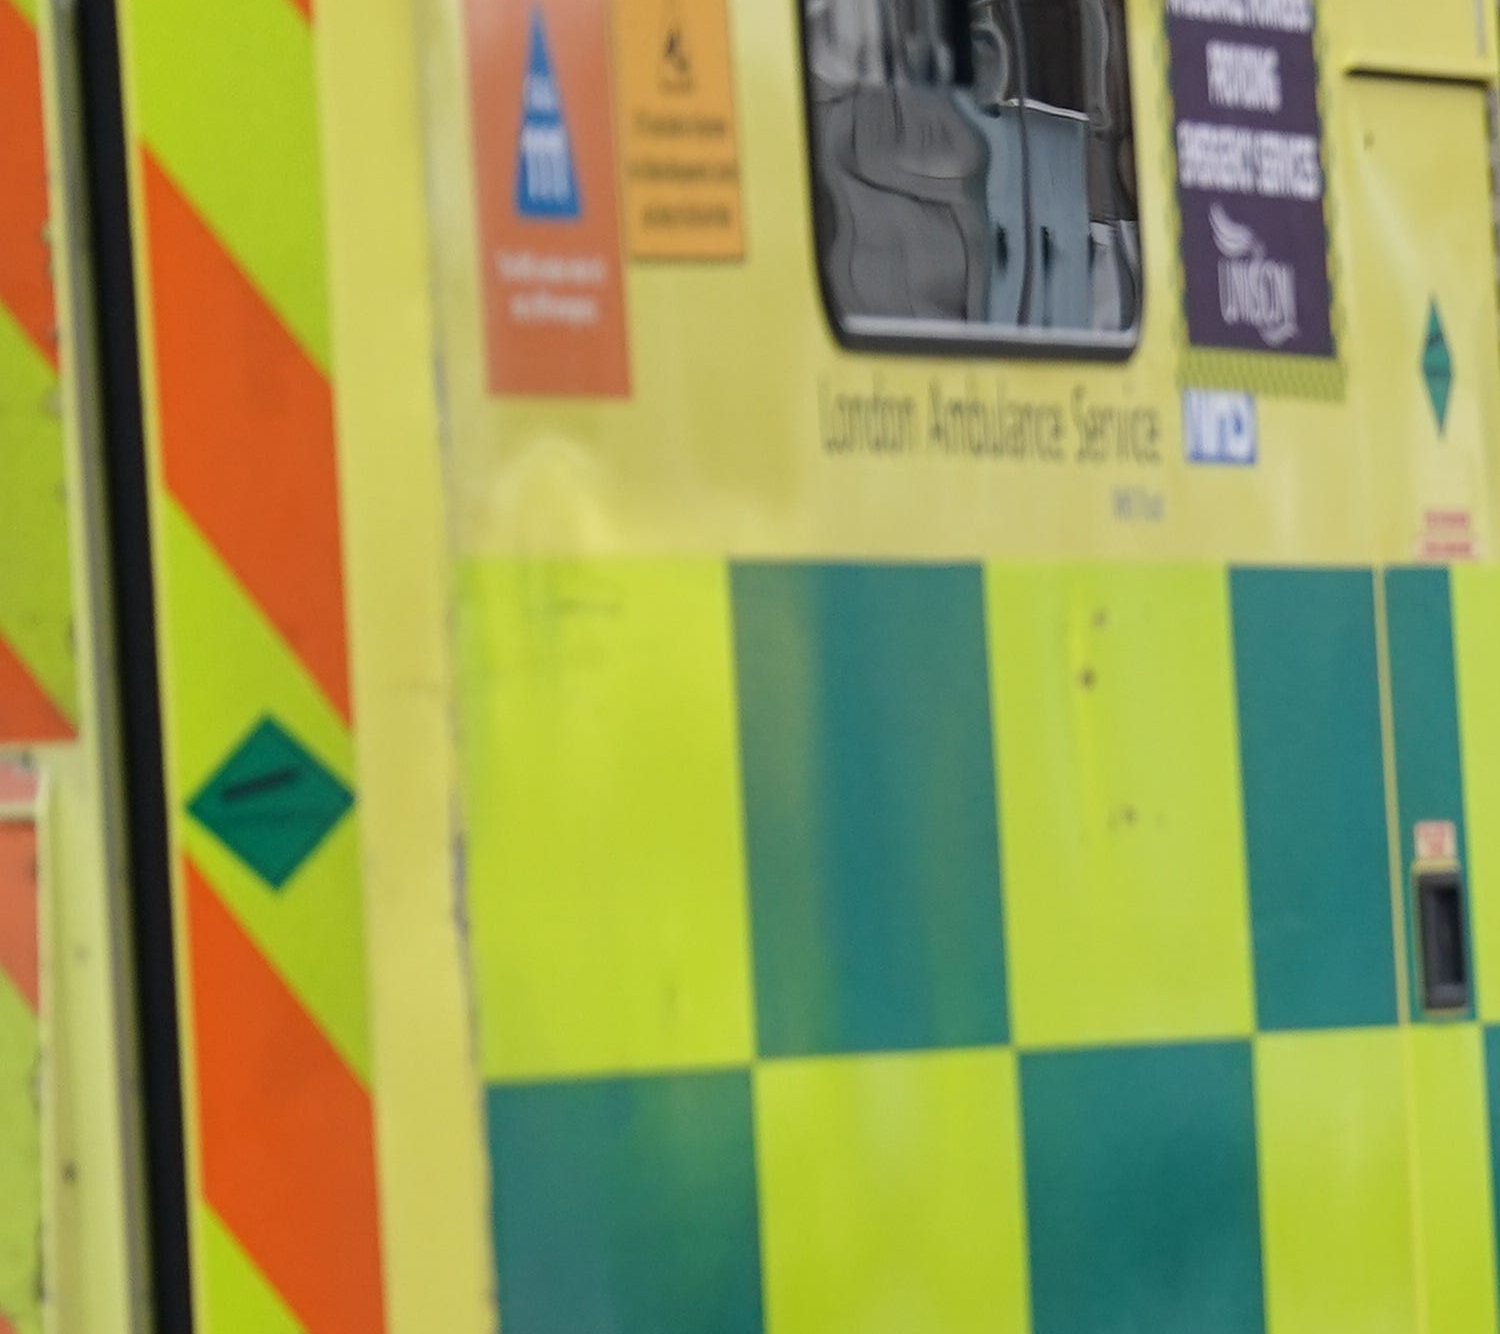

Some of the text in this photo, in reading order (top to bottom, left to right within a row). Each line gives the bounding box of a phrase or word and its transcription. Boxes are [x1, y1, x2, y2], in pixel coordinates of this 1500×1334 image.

[817, 369, 1162, 465] London Ambulance Service
